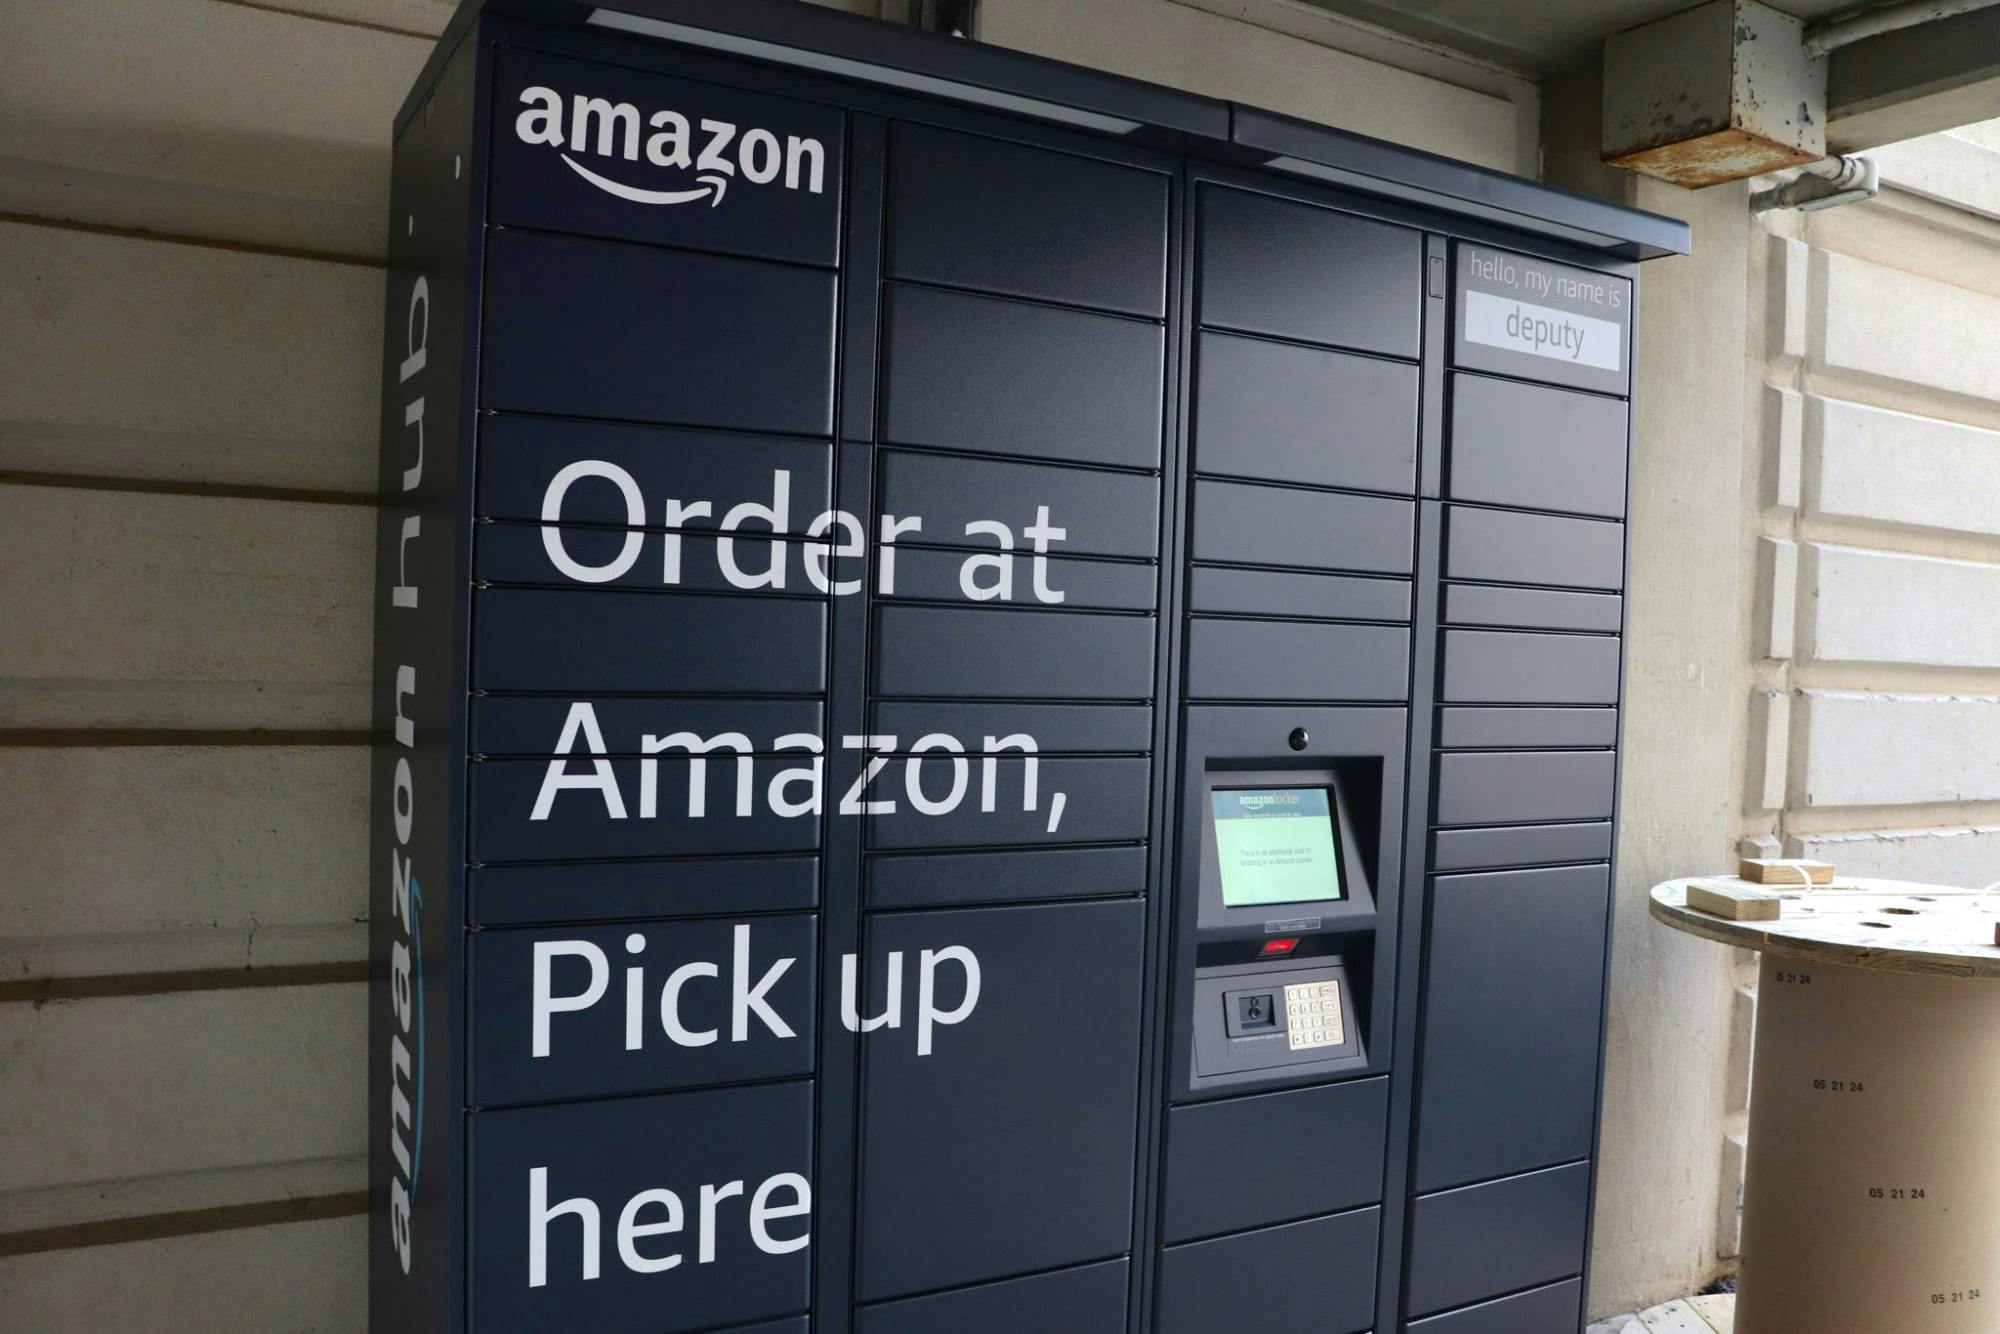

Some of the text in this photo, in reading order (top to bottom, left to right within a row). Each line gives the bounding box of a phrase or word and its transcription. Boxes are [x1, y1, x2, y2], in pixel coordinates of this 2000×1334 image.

[515, 86, 825, 196] amazon
[1471, 250, 1621, 309] hello, my name is
[1506, 305, 1584, 360] deputy
[540, 459, 1067, 604] Order at
[391, 275, 429, 1275] amazon hub
[529, 701, 1067, 833] Amazon,
[532, 924, 982, 1058] Pick up
[1787, 973, 1796, 984] 21
[1813, 1079, 1863, 1092] 05 21 24
[528, 1166, 813, 1288] here
[1869, 1187, 1925, 1199] 05 21 24
[1931, 1289, 1980, 1304] 05 21 24
